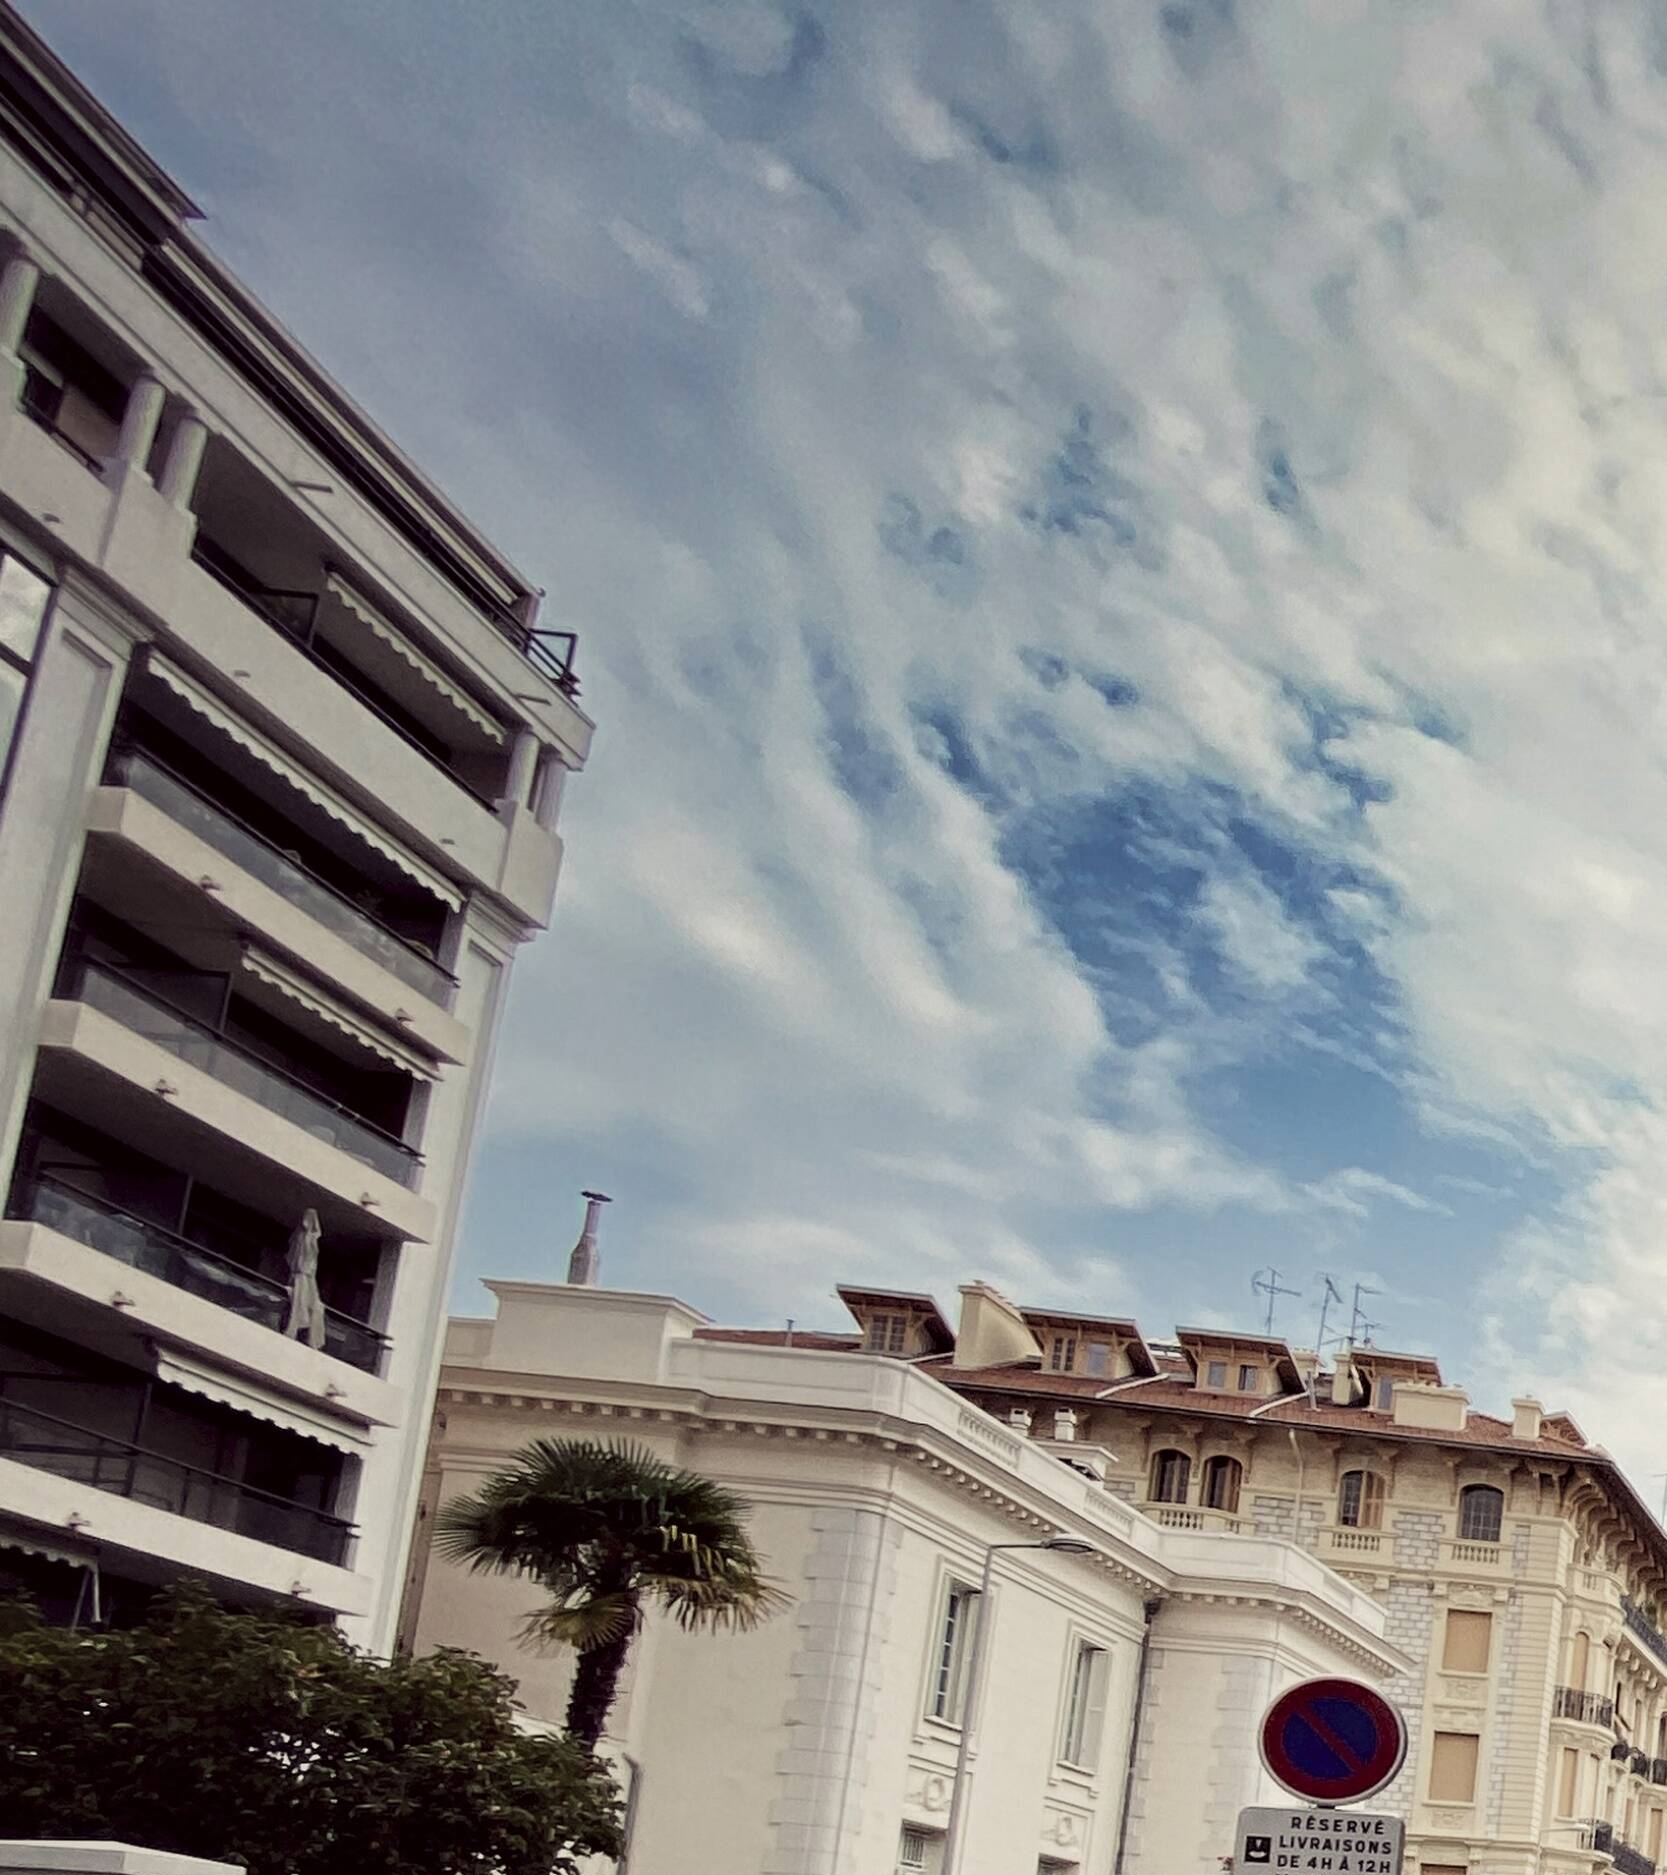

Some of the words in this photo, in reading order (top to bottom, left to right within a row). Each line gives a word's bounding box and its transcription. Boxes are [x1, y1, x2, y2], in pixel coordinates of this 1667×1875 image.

[1291, 1815, 1385, 1835] RÉSERVÉ
[1279, 1835, 1392, 1855] LIVRAISONS
[1277, 1854, 1300, 1868] DE
[1358, 1860, 1391, 1874] 12H
